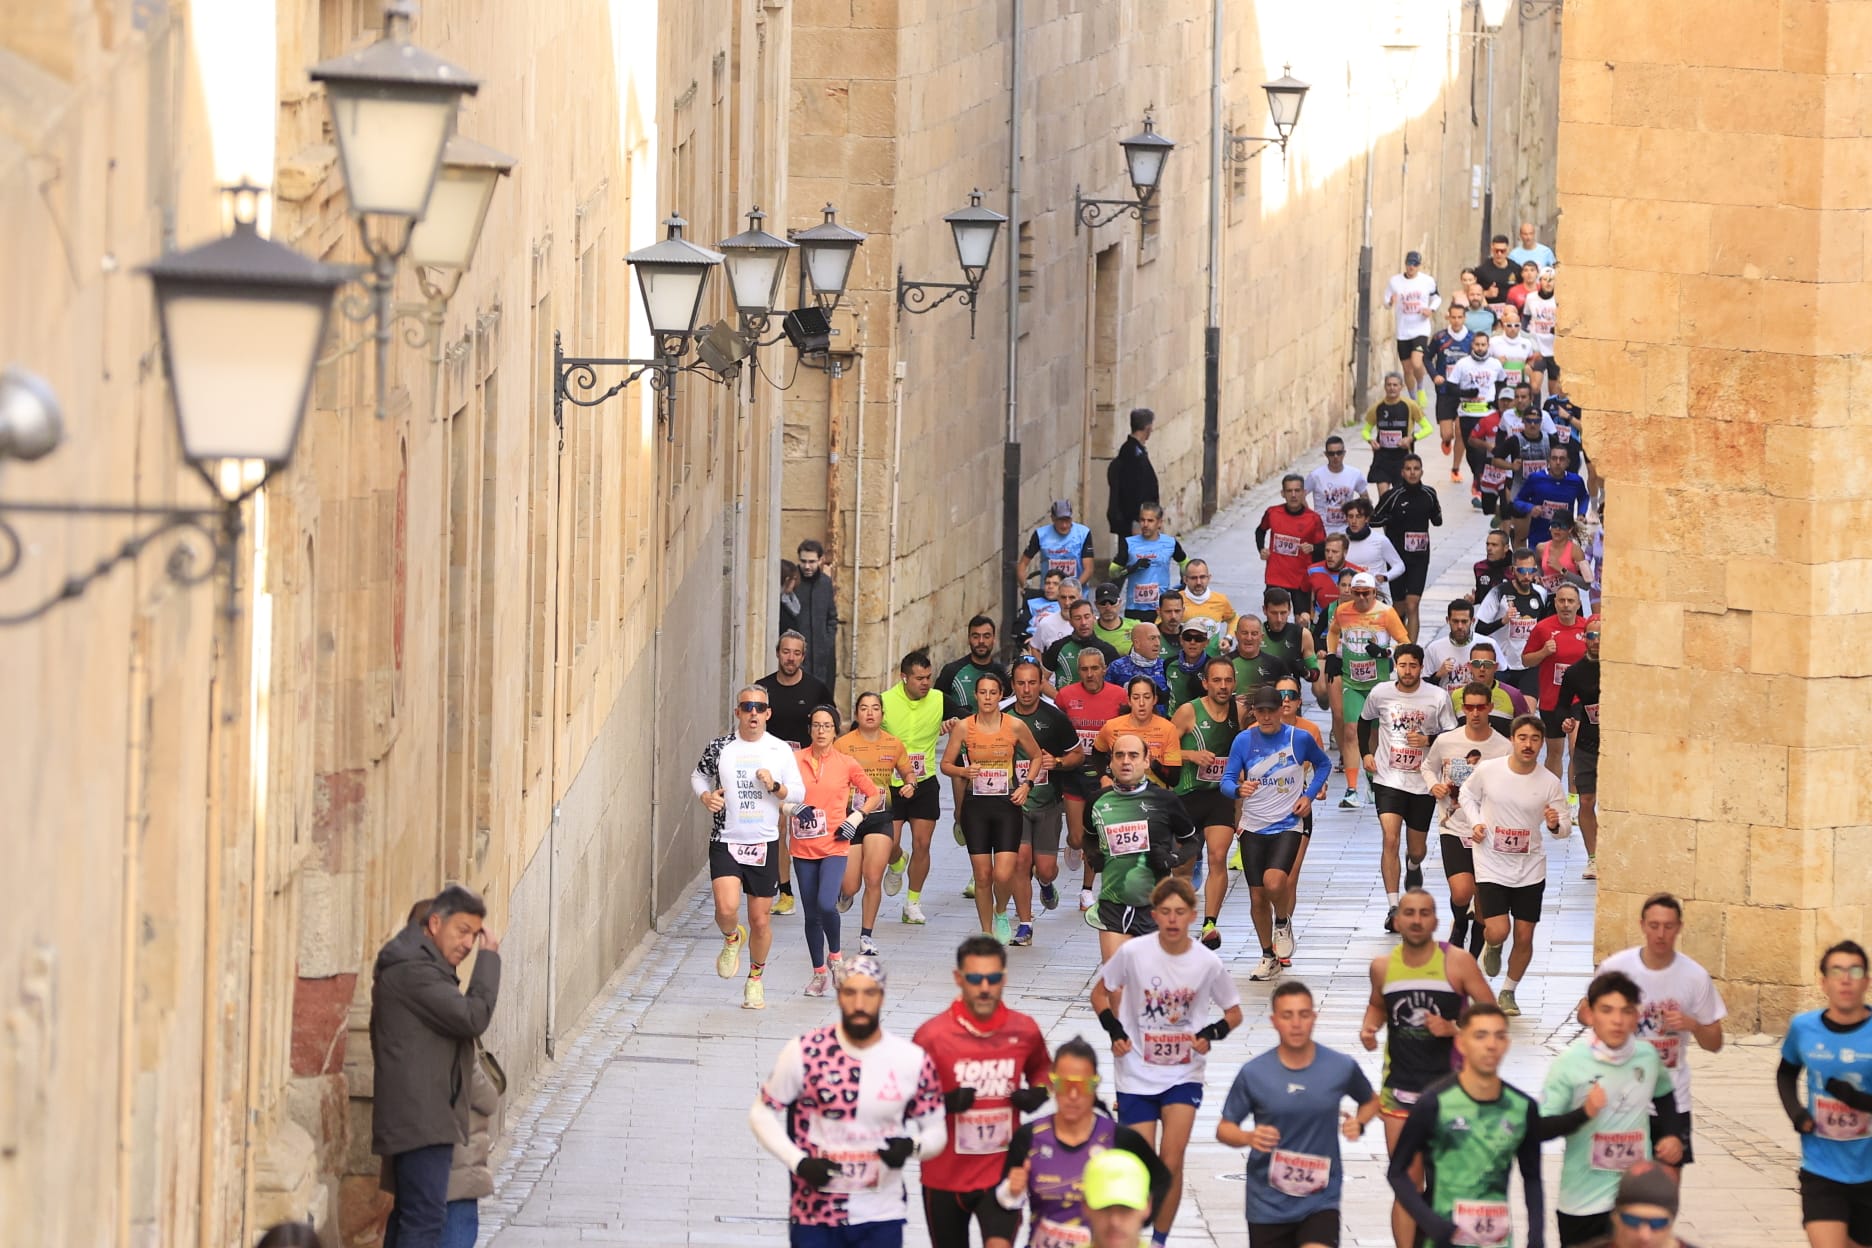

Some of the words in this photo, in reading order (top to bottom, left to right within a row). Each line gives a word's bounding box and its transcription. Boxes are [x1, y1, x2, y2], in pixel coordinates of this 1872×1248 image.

[1355, 668, 1371, 676] 254
[1396, 754, 1415, 764] 217
[737, 770, 747, 779] 32
[737, 781, 754, 789] LIGA
[986, 778, 994, 787] 4
[738, 790, 763, 800] CROSS
[1116, 832, 1139, 845] 256
[1504, 836, 1519, 847] 41
[737, 846, 758, 856] 644
[1154, 1043, 1180, 1056] 231
[977, 1125, 995, 1140] 17
[1604, 1143, 1635, 1158] 674
[1283, 1166, 1315, 1183] 234
